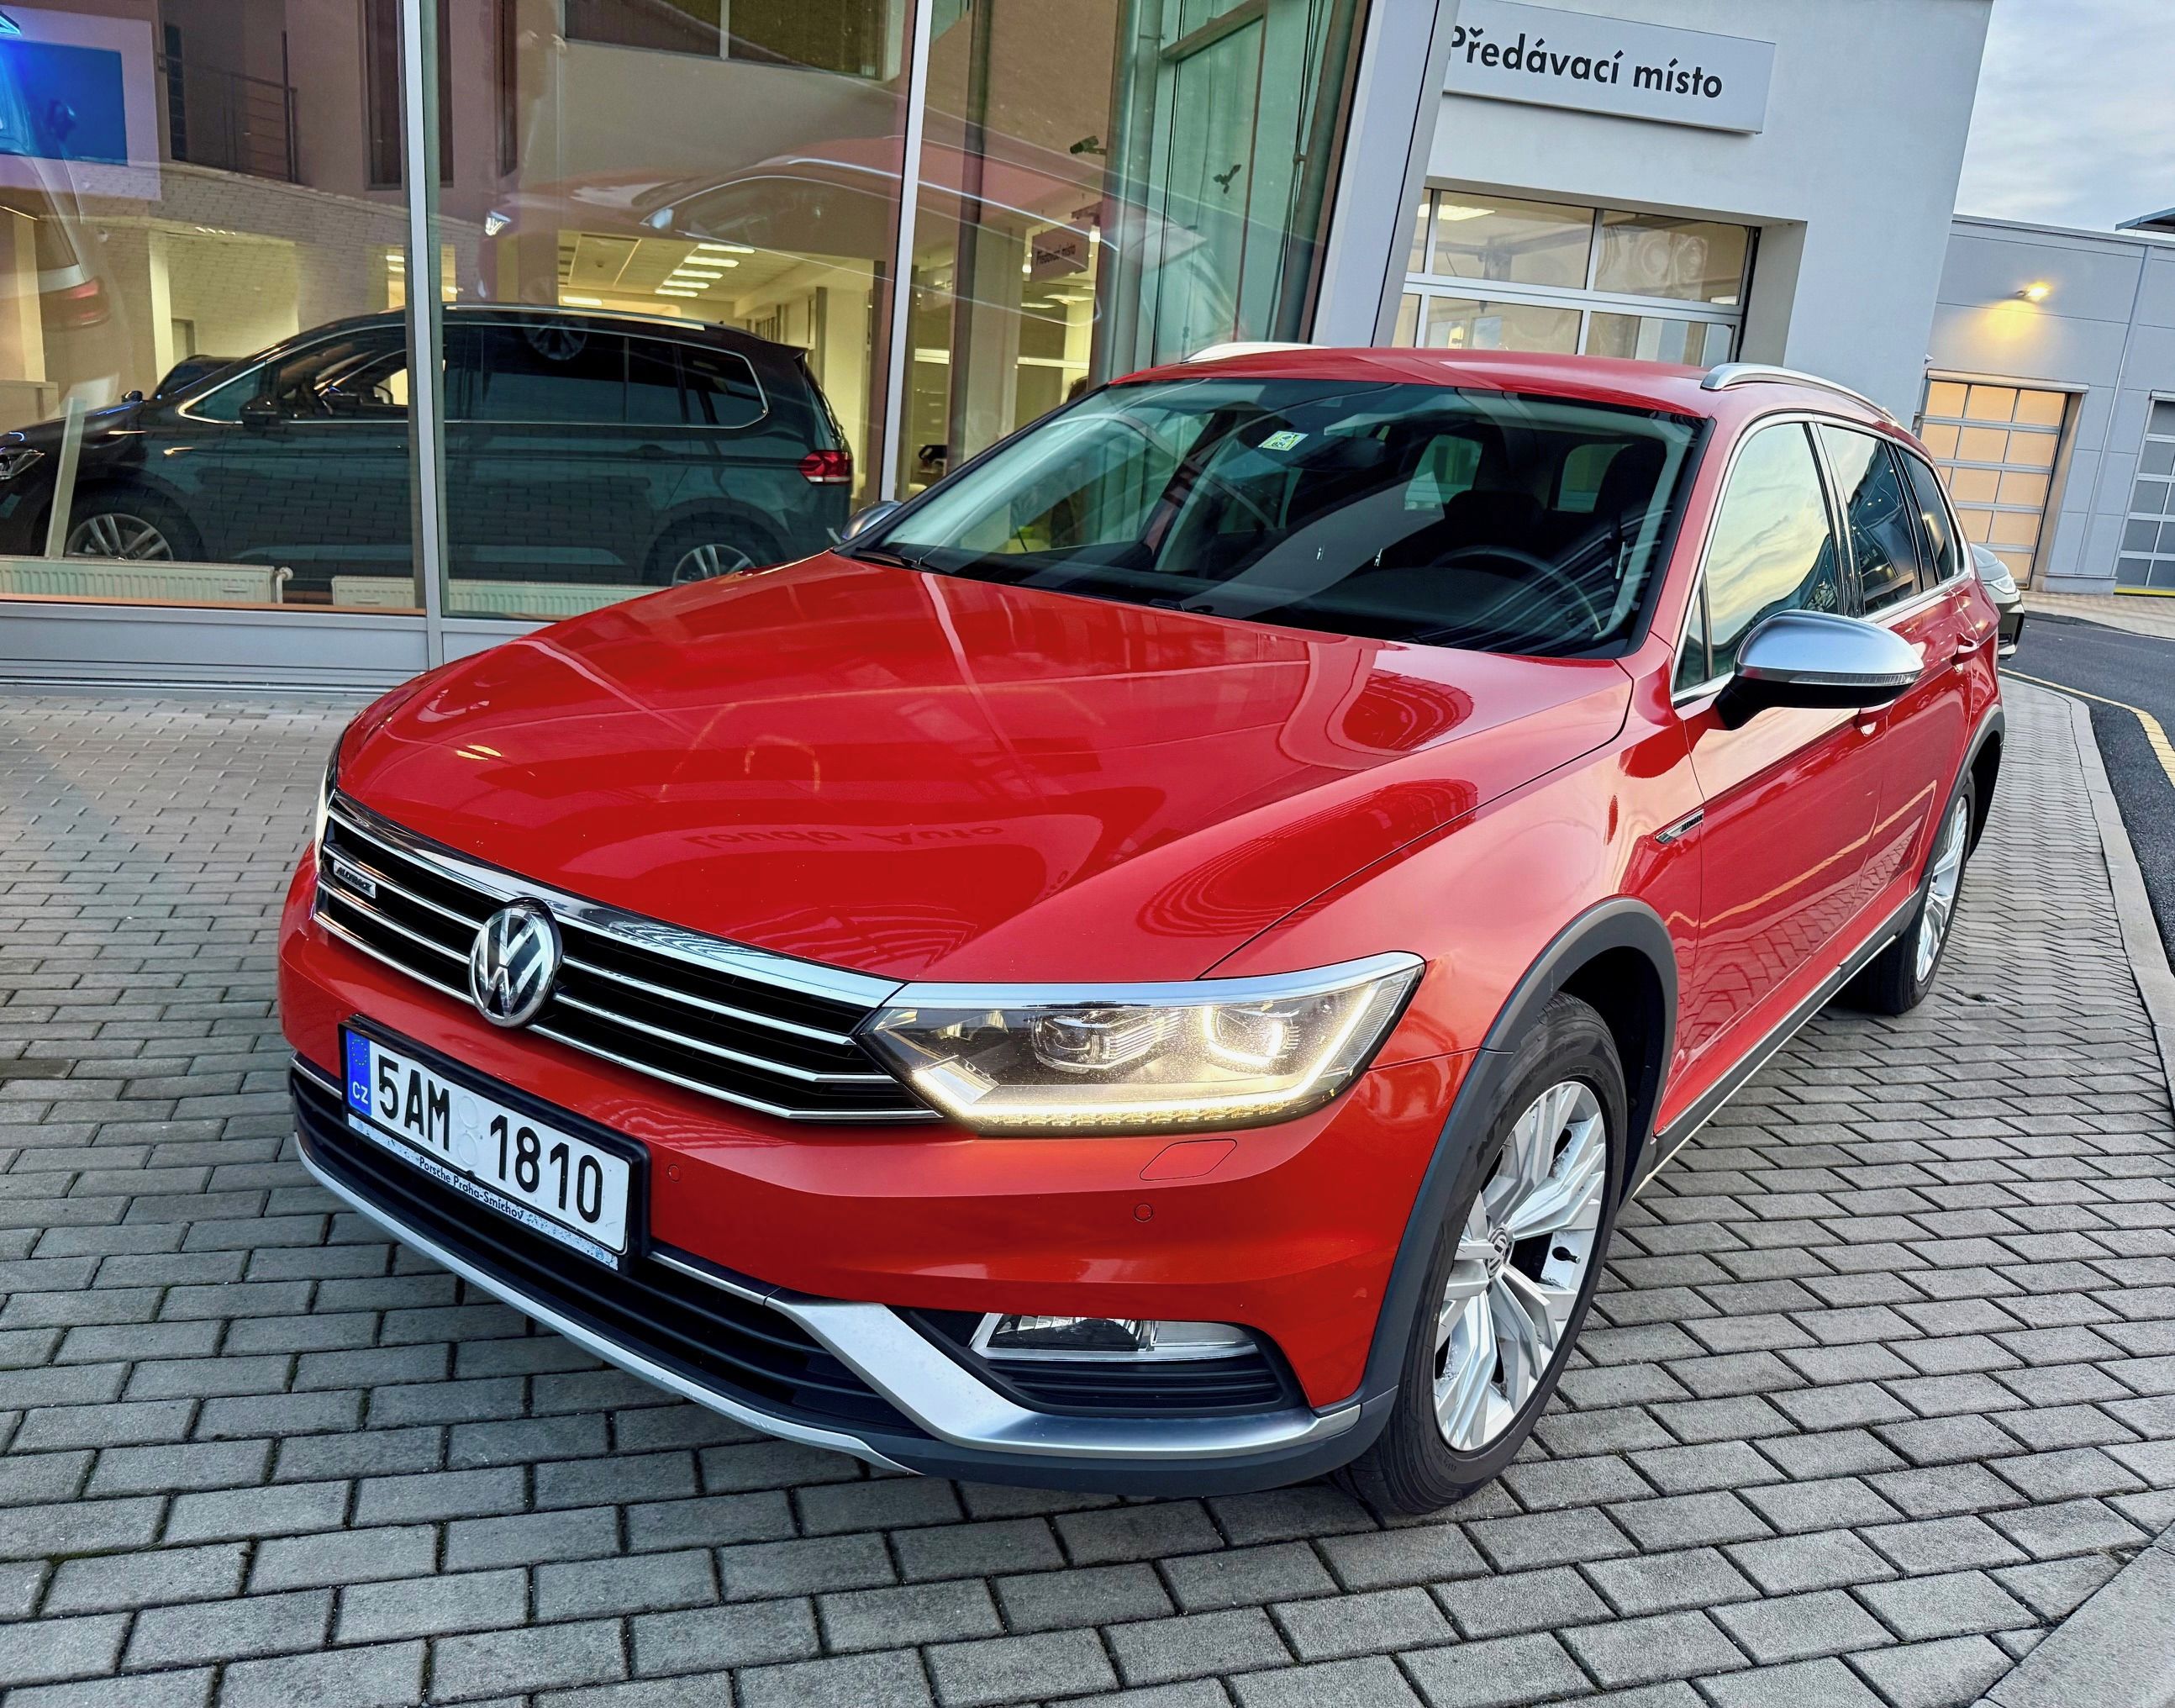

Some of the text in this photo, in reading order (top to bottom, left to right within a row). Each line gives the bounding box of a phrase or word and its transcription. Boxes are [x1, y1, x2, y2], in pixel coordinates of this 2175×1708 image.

[1633, 58, 1723, 98] místo
[351, 1081, 369, 1105] CZ
[378, 1054, 603, 1224] 5AM 1810
[419, 1156, 524, 1220] Porsche Praha-Smíchov
